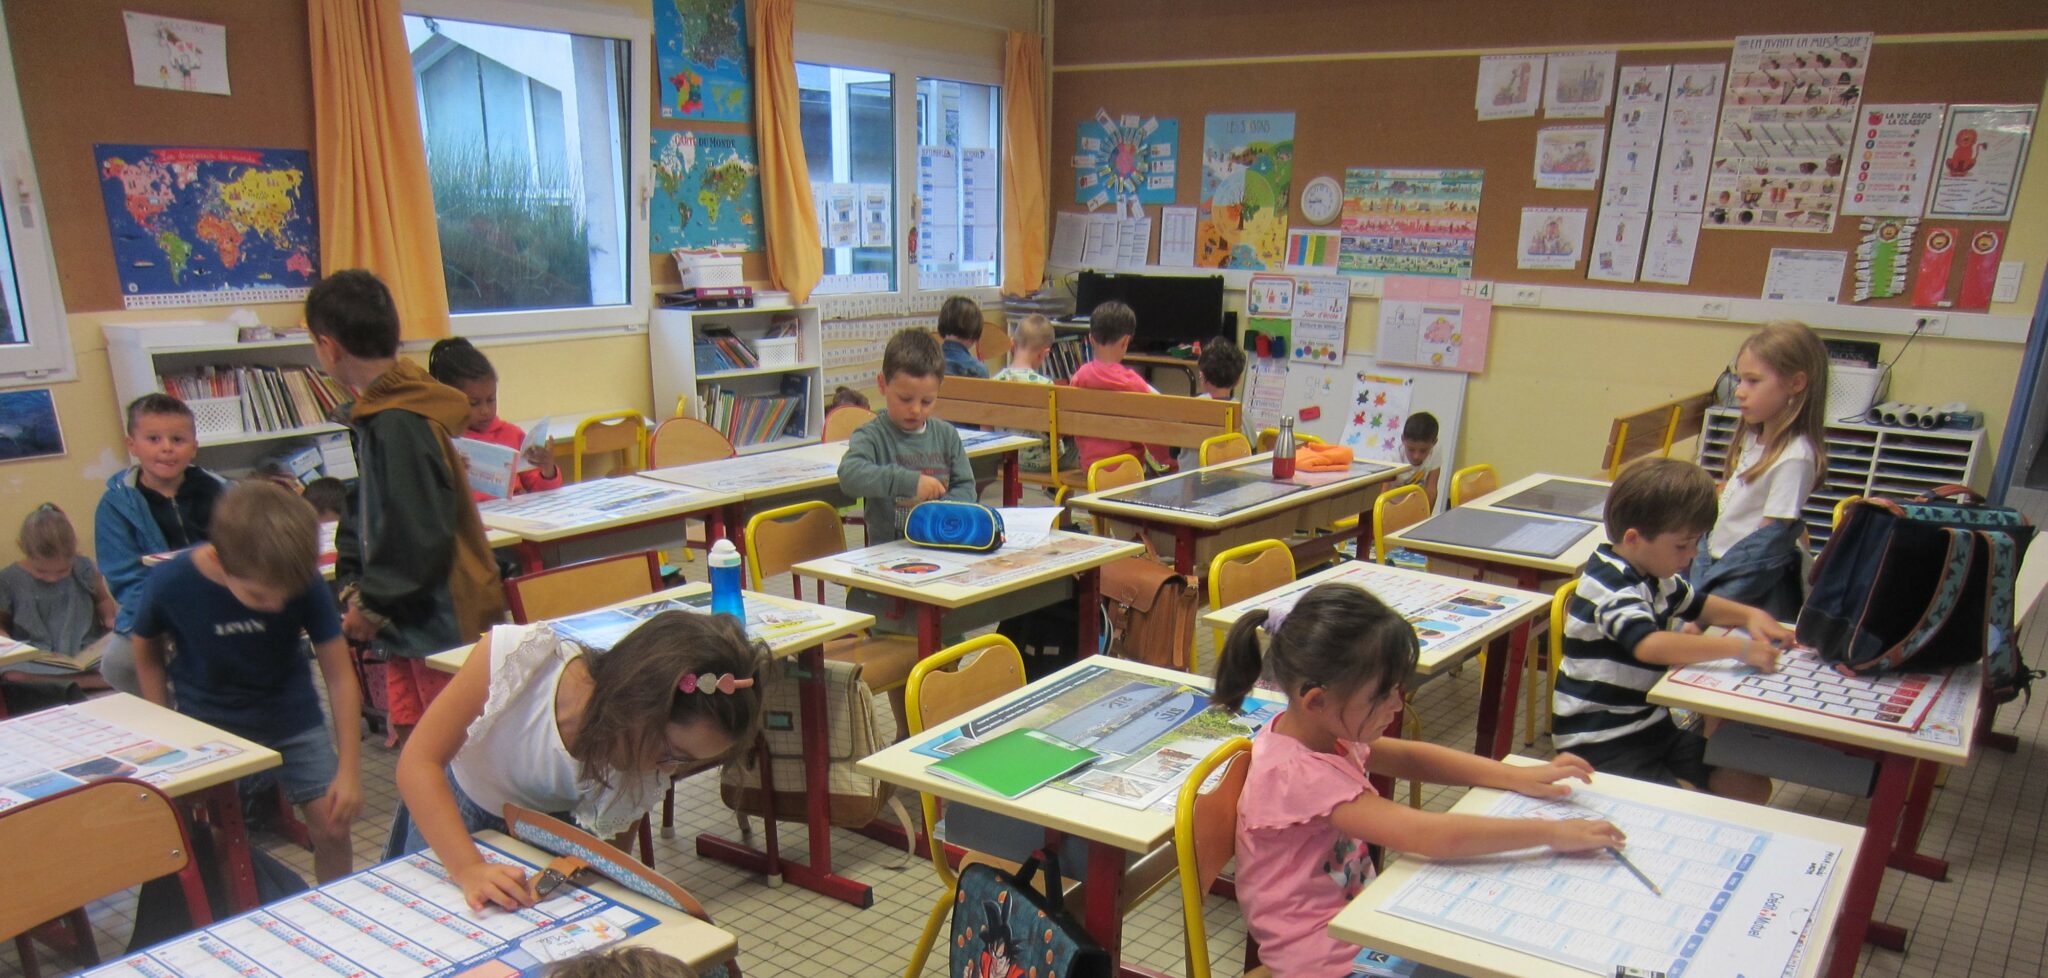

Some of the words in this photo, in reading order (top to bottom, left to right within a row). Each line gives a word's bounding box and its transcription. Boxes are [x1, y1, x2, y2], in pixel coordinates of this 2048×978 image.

[1764, 38, 1793, 49] AVANT
[1796, 38, 1808, 48] LA
[1810, 35, 1861, 48] MUSIQUE
[698, 137, 709, 147] DU
[710, 137, 736, 148] MONDE
[1480, 283, 1489, 297] 4
[1763, 891, 1784, 911] Crédit
[1747, 916, 1771, 939] Mutuel
